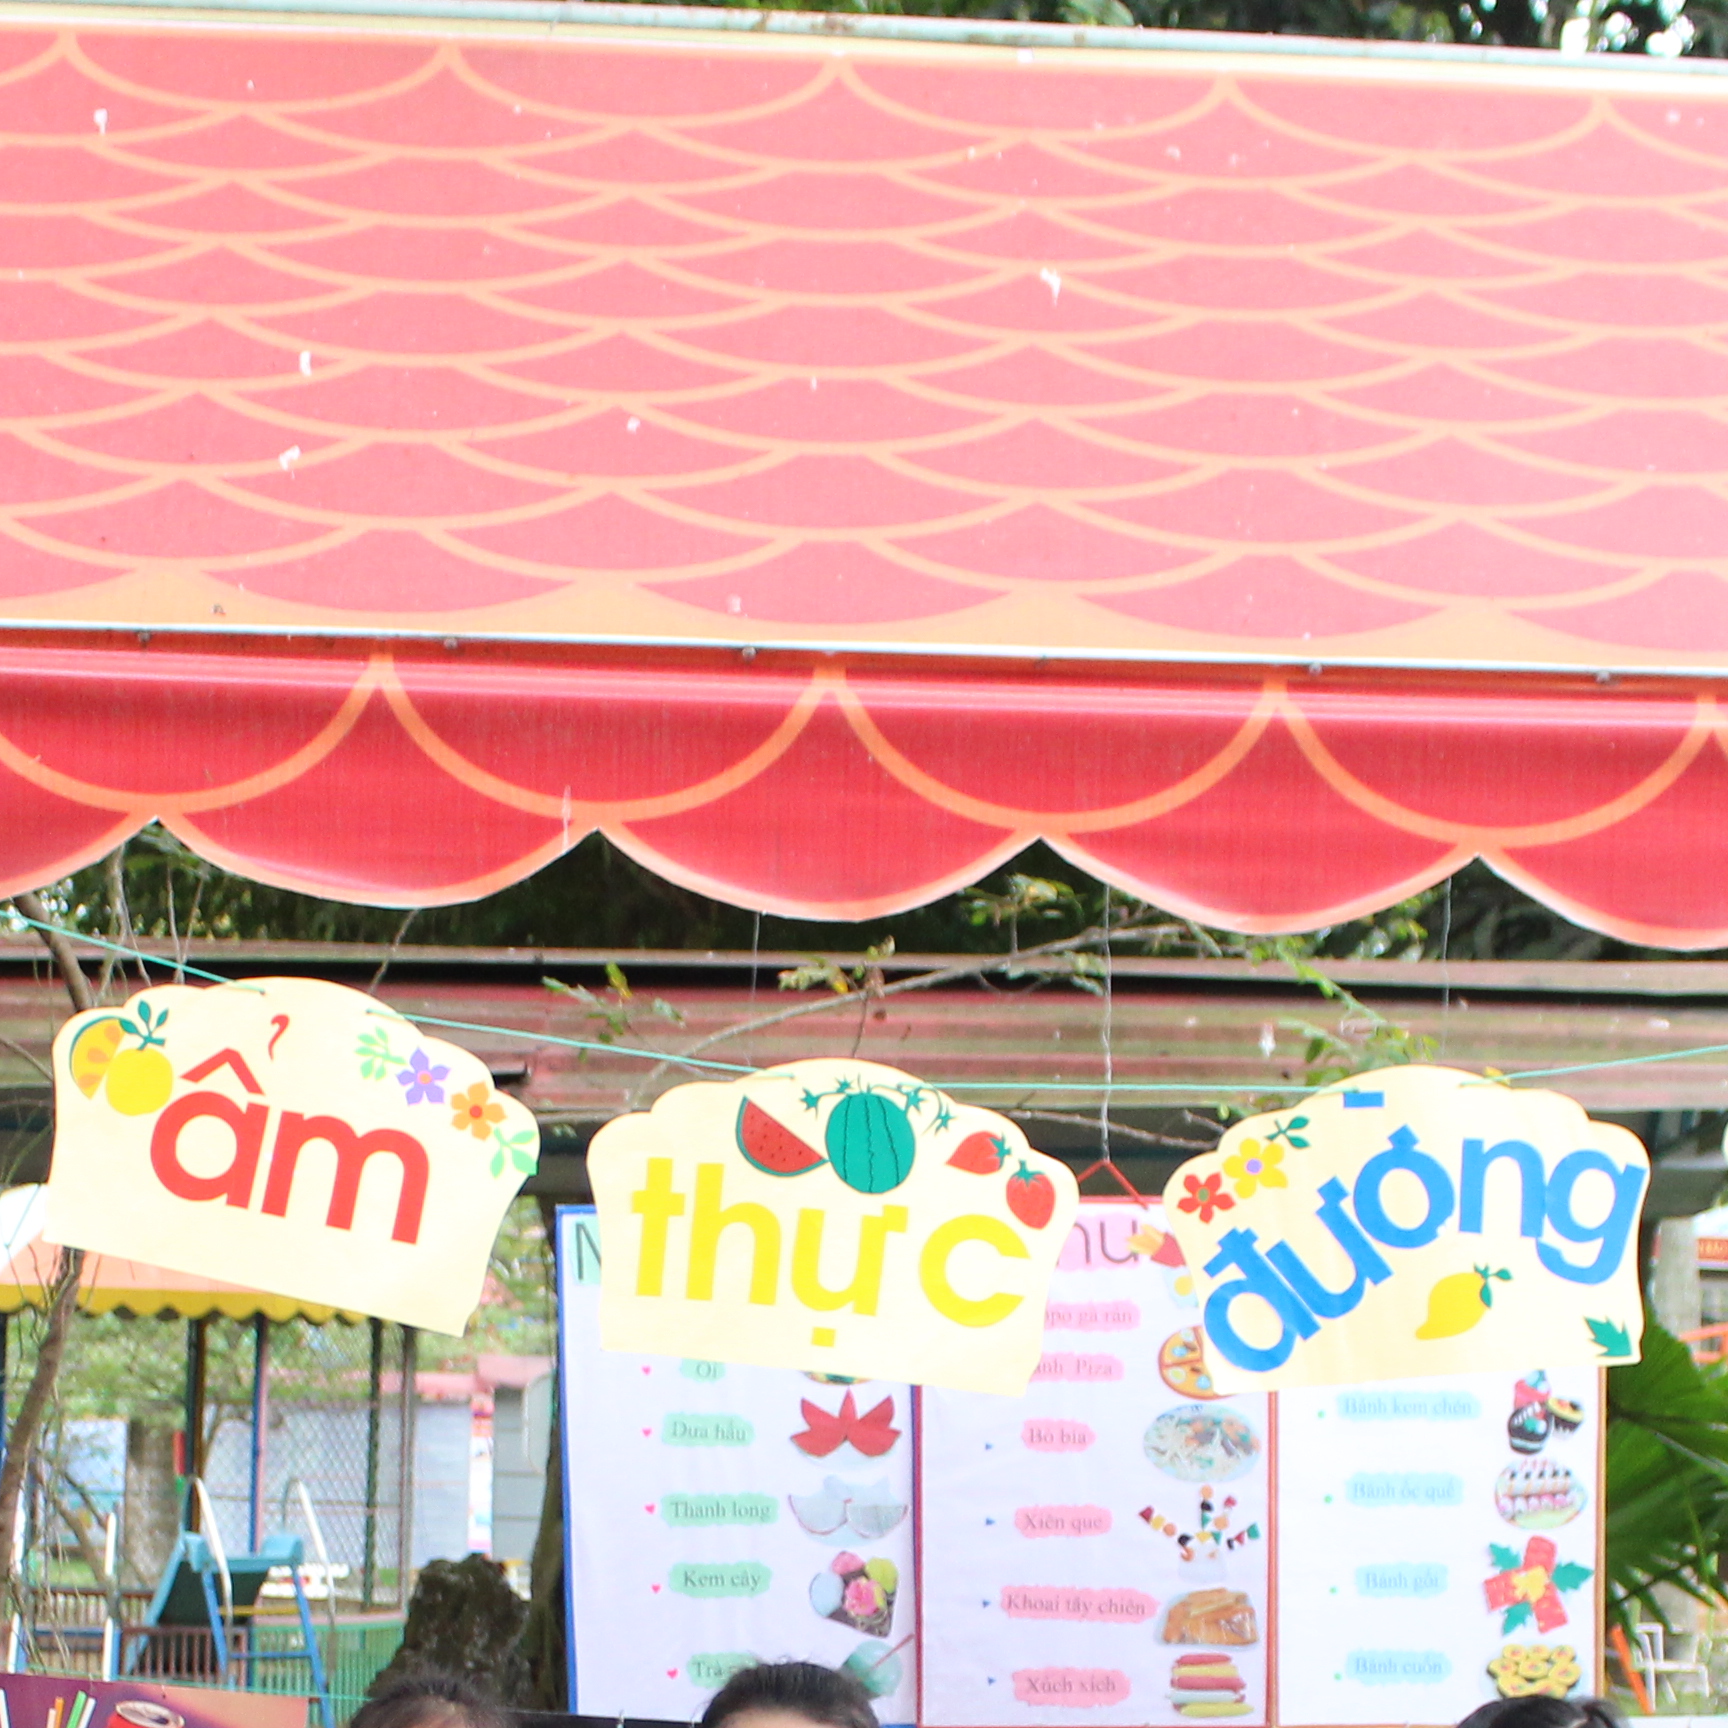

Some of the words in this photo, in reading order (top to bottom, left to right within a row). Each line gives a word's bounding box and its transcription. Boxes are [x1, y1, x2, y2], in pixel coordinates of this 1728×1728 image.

[150, 1014, 430, 1244] ẩm
[631, 1158, 1031, 1346] thực
[670, 1500, 727, 1519] Thanh
[732, 1501, 771, 1521] long
[683, 1570, 725, 1588] Kem
[1007, 1594, 1059, 1611] Khoai
